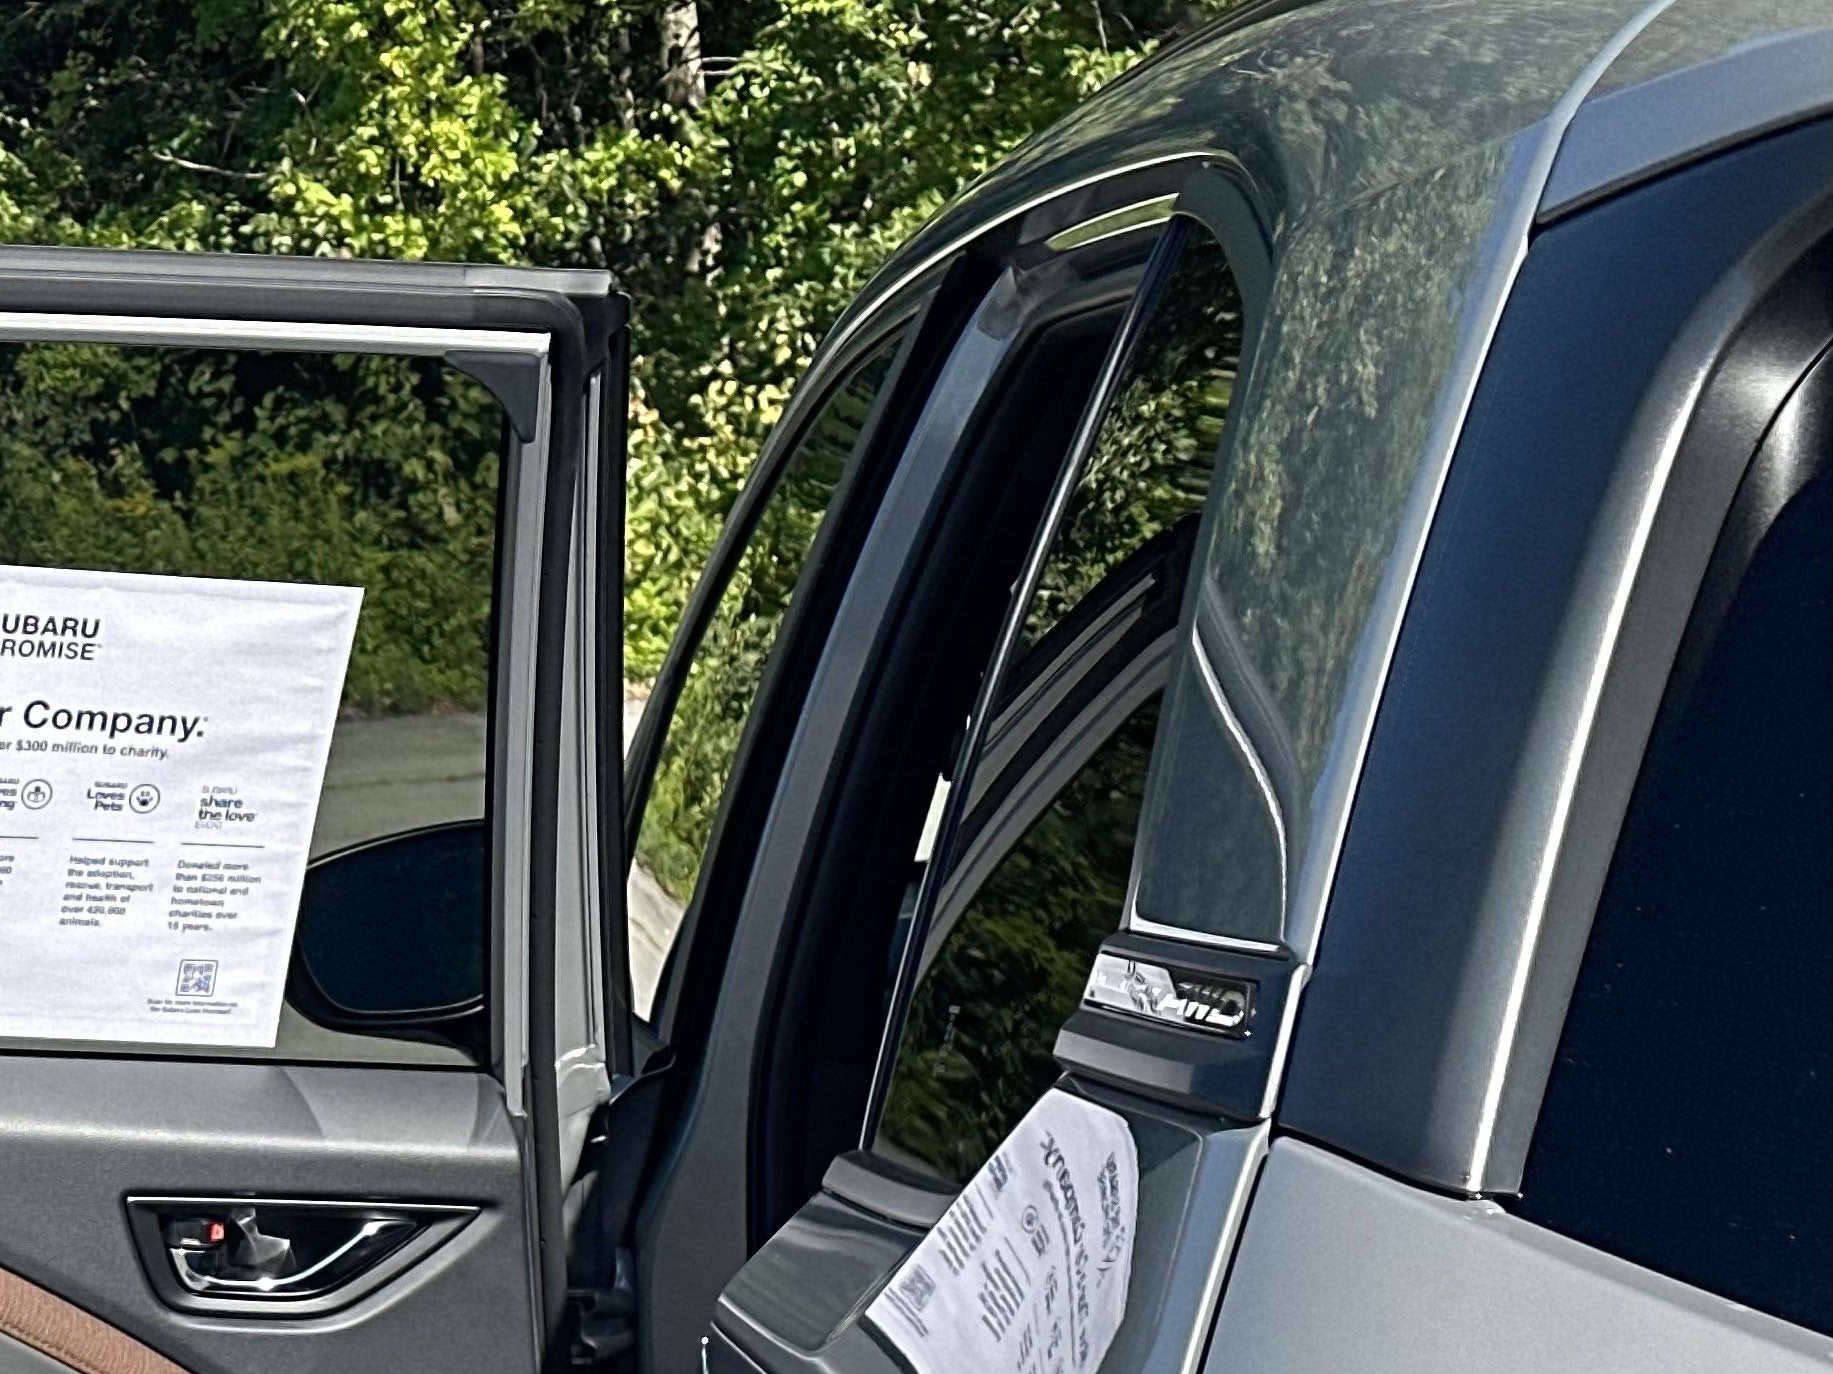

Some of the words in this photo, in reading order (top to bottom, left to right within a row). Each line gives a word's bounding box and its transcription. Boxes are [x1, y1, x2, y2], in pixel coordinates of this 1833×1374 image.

[23, 700, 205, 743] Company.
[16, 738, 48, 753] $300
[51, 740, 99, 755] million
[103, 744, 117, 756] to
[120, 745, 169, 761] charity.
[87, 788, 126, 801] Loves
[200, 794, 244, 809] share
[94, 799, 124, 812] Pets
[198, 808, 223, 821] the
[225, 808, 256, 823] love
